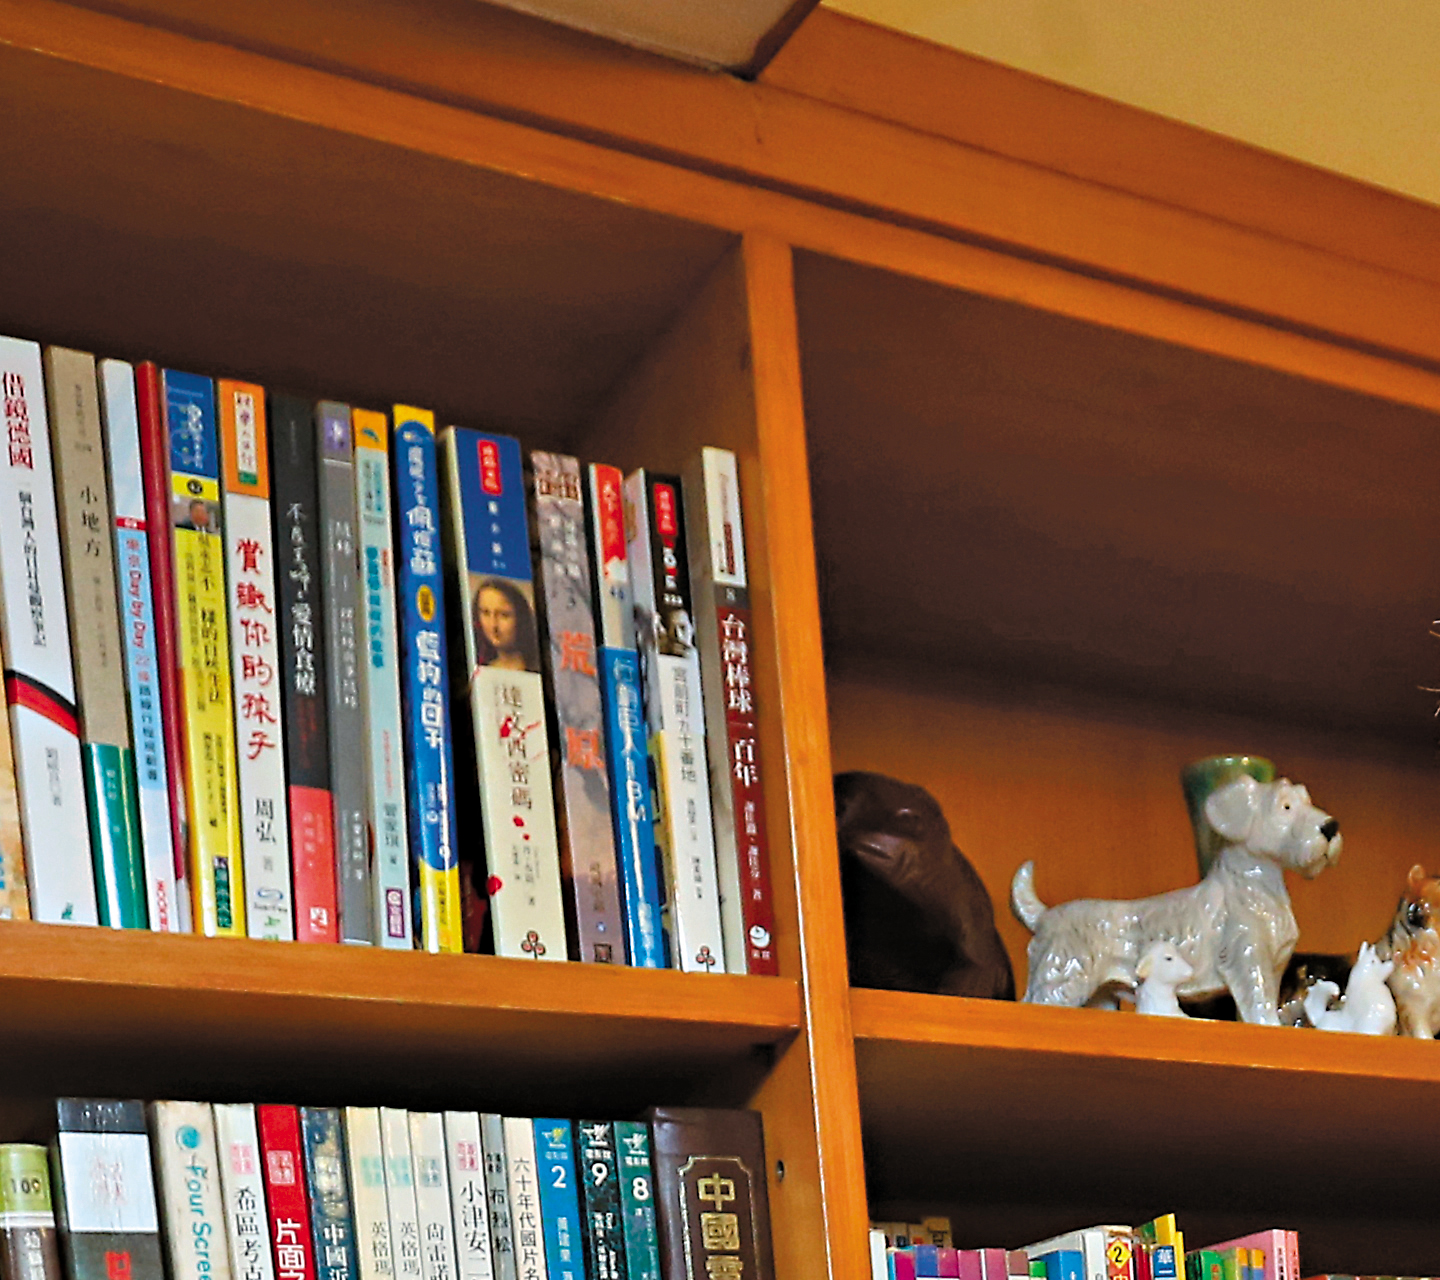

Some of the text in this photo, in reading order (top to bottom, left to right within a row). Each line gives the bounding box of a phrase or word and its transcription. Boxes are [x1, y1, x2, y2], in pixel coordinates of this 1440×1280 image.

[235, 537, 278, 760] 賞識你的孩子
[184, 1153, 209, 1217] Four
[551, 1165, 567, 1189] 2
[591, 1163, 609, 1186] 9
[632, 1177, 650, 1201] 8
